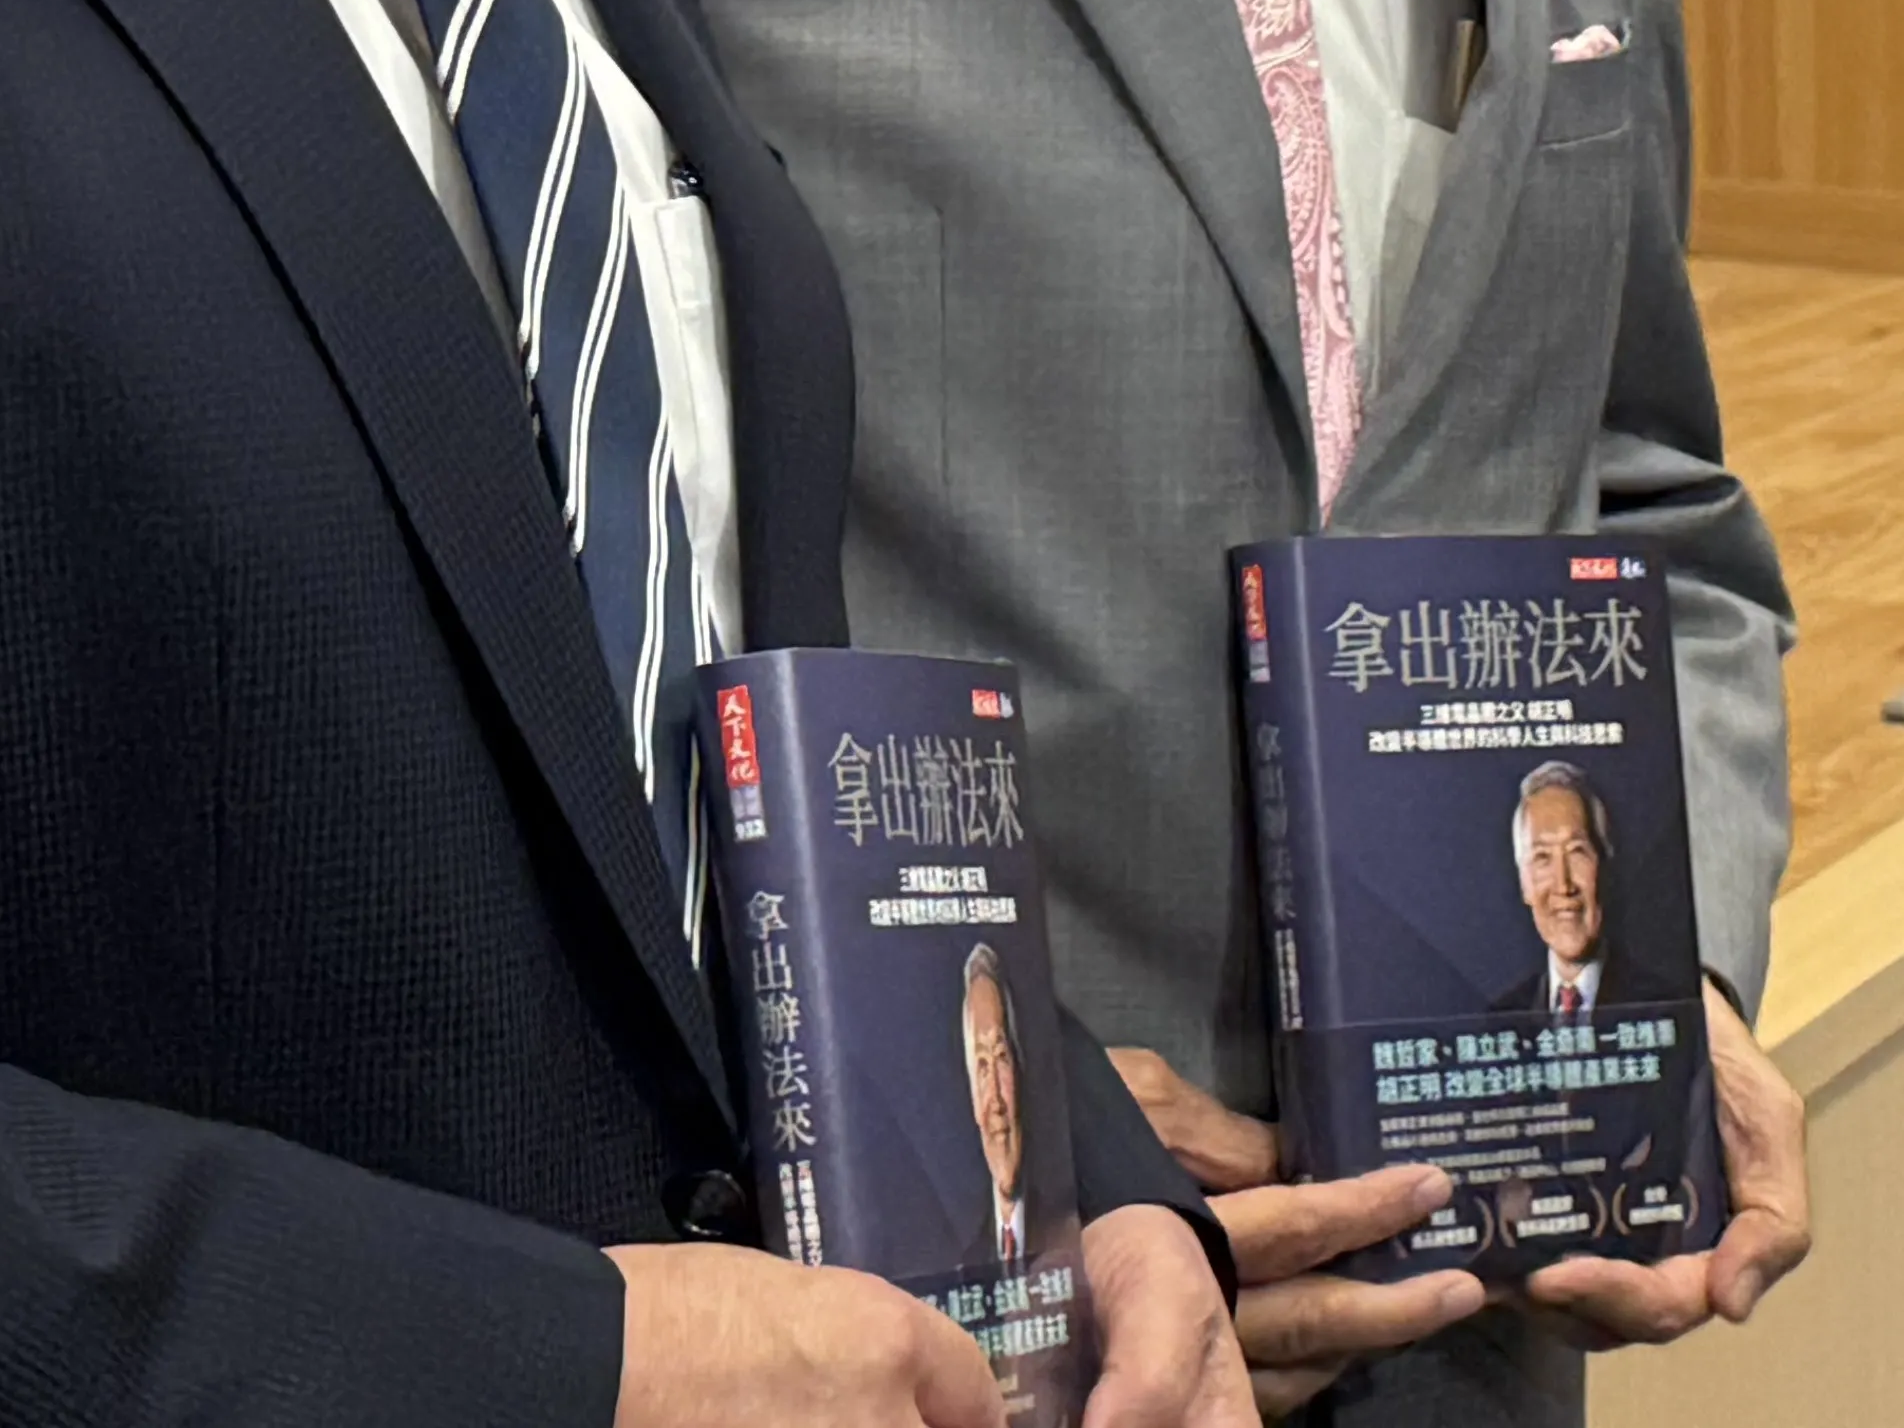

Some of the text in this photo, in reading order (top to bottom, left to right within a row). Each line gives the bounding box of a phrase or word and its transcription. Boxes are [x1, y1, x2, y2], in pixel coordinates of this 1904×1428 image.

[1323, 598, 1648, 693] 拿出辦法來
[827, 732, 1024, 847] 拿出辦法來
[746, 890, 816, 1152] 拿出辦法來
